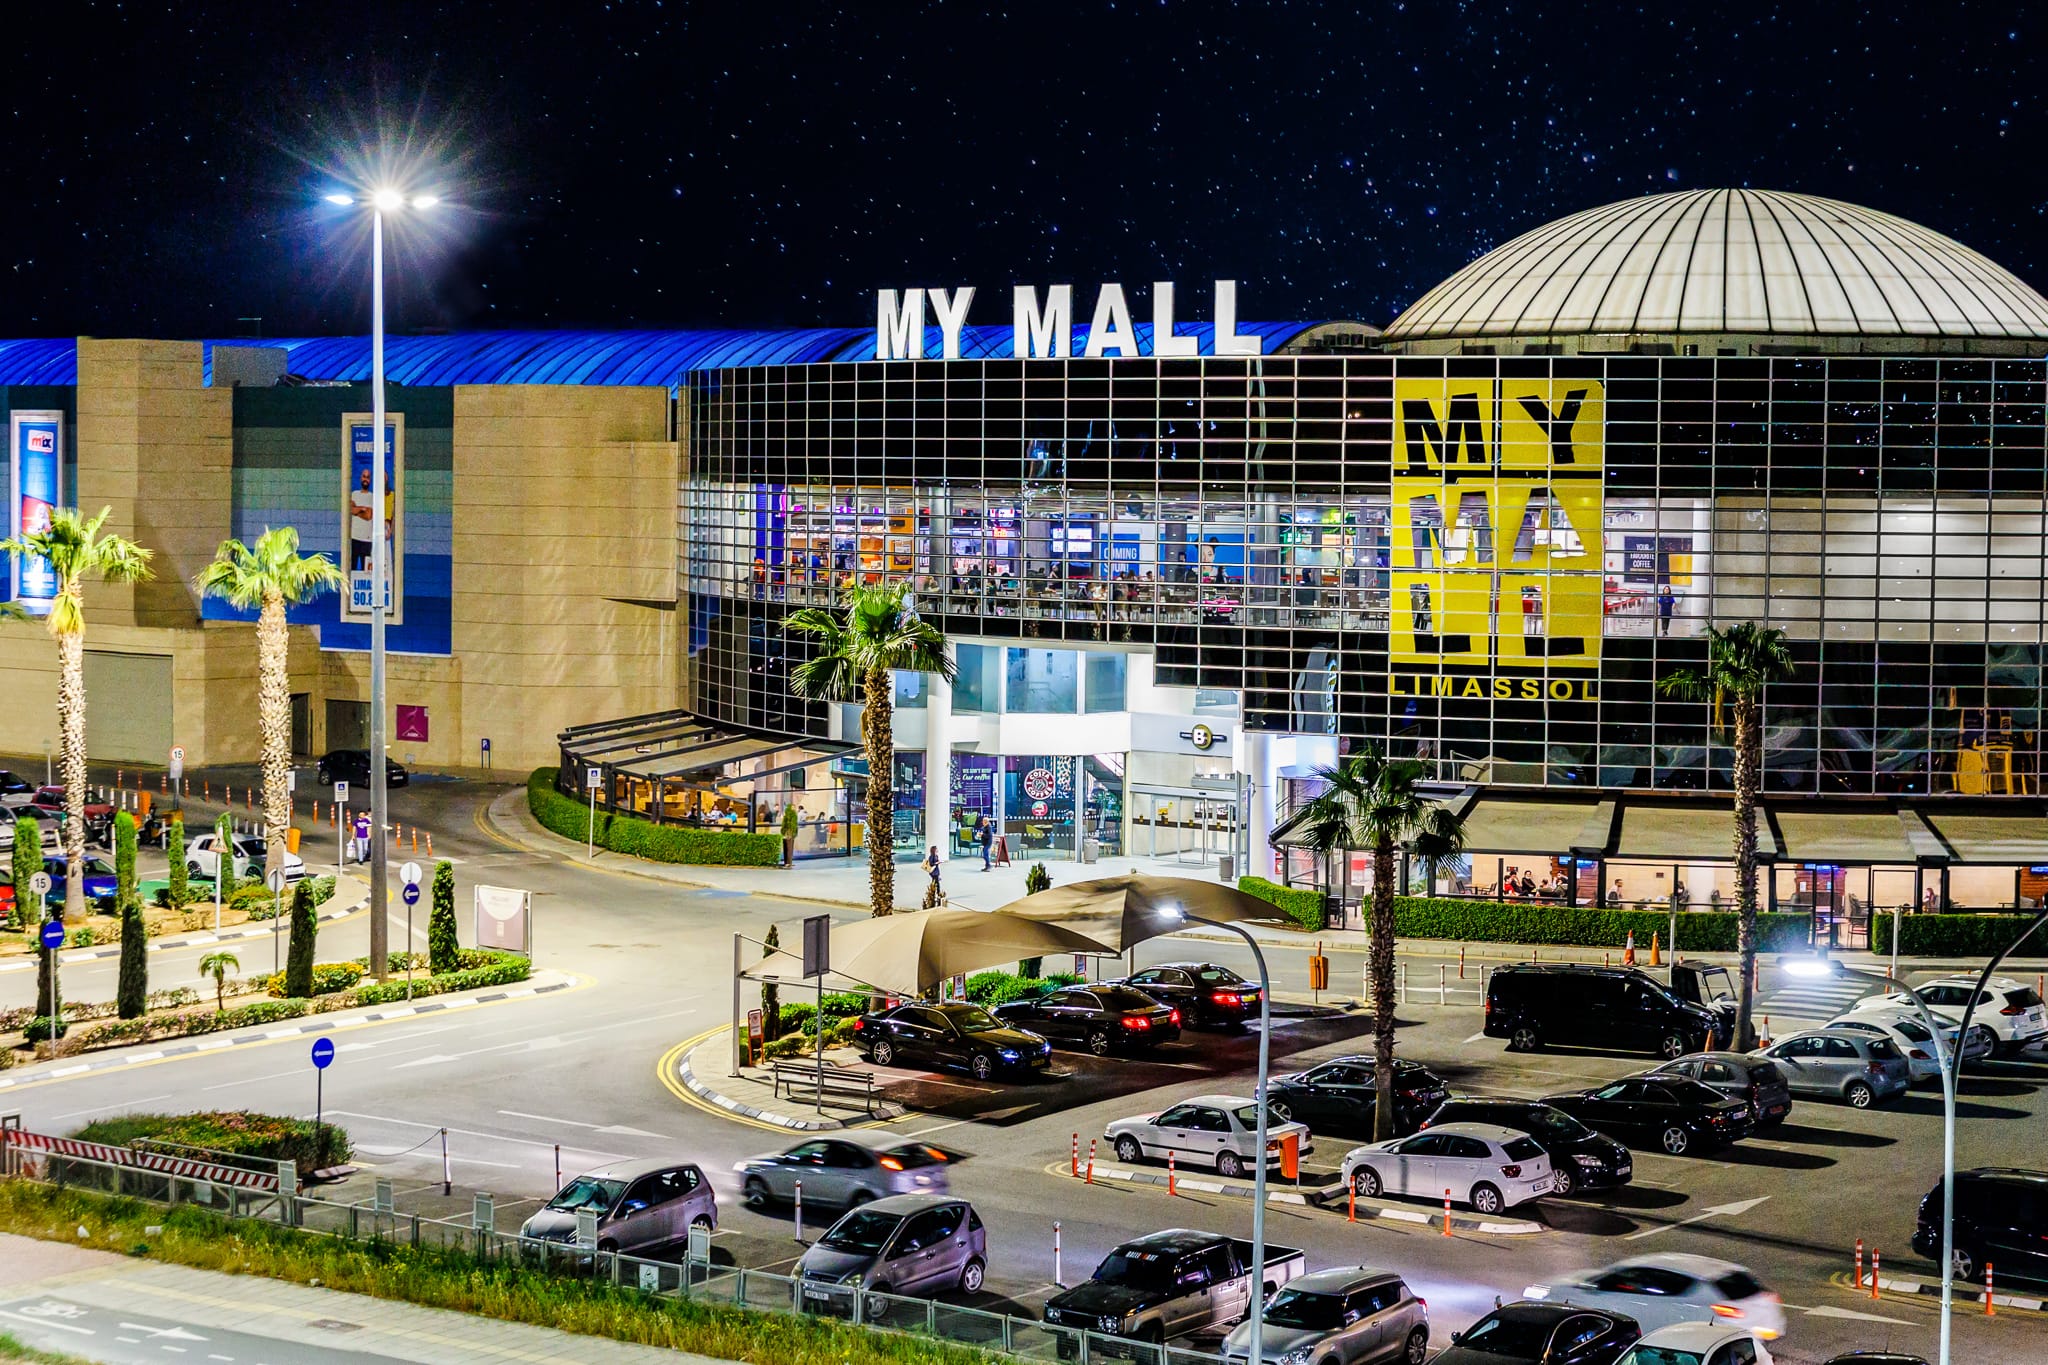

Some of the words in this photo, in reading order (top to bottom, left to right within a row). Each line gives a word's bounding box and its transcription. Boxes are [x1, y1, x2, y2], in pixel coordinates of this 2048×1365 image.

[876, 286, 976, 359] MY
[1013, 280, 1262, 358] MALL
[1402, 389, 1588, 469] MY
[1409, 487, 1588, 568] MA
[1409, 583, 1585, 656] LL
[1389, 674, 1600, 701] LIMASSOL
[174, 750, 183, 759] 15
[1029, 771, 1050, 780] COSTA
[1028, 786, 1053, 798] COFFEE
[35, 878, 47, 888] 15
